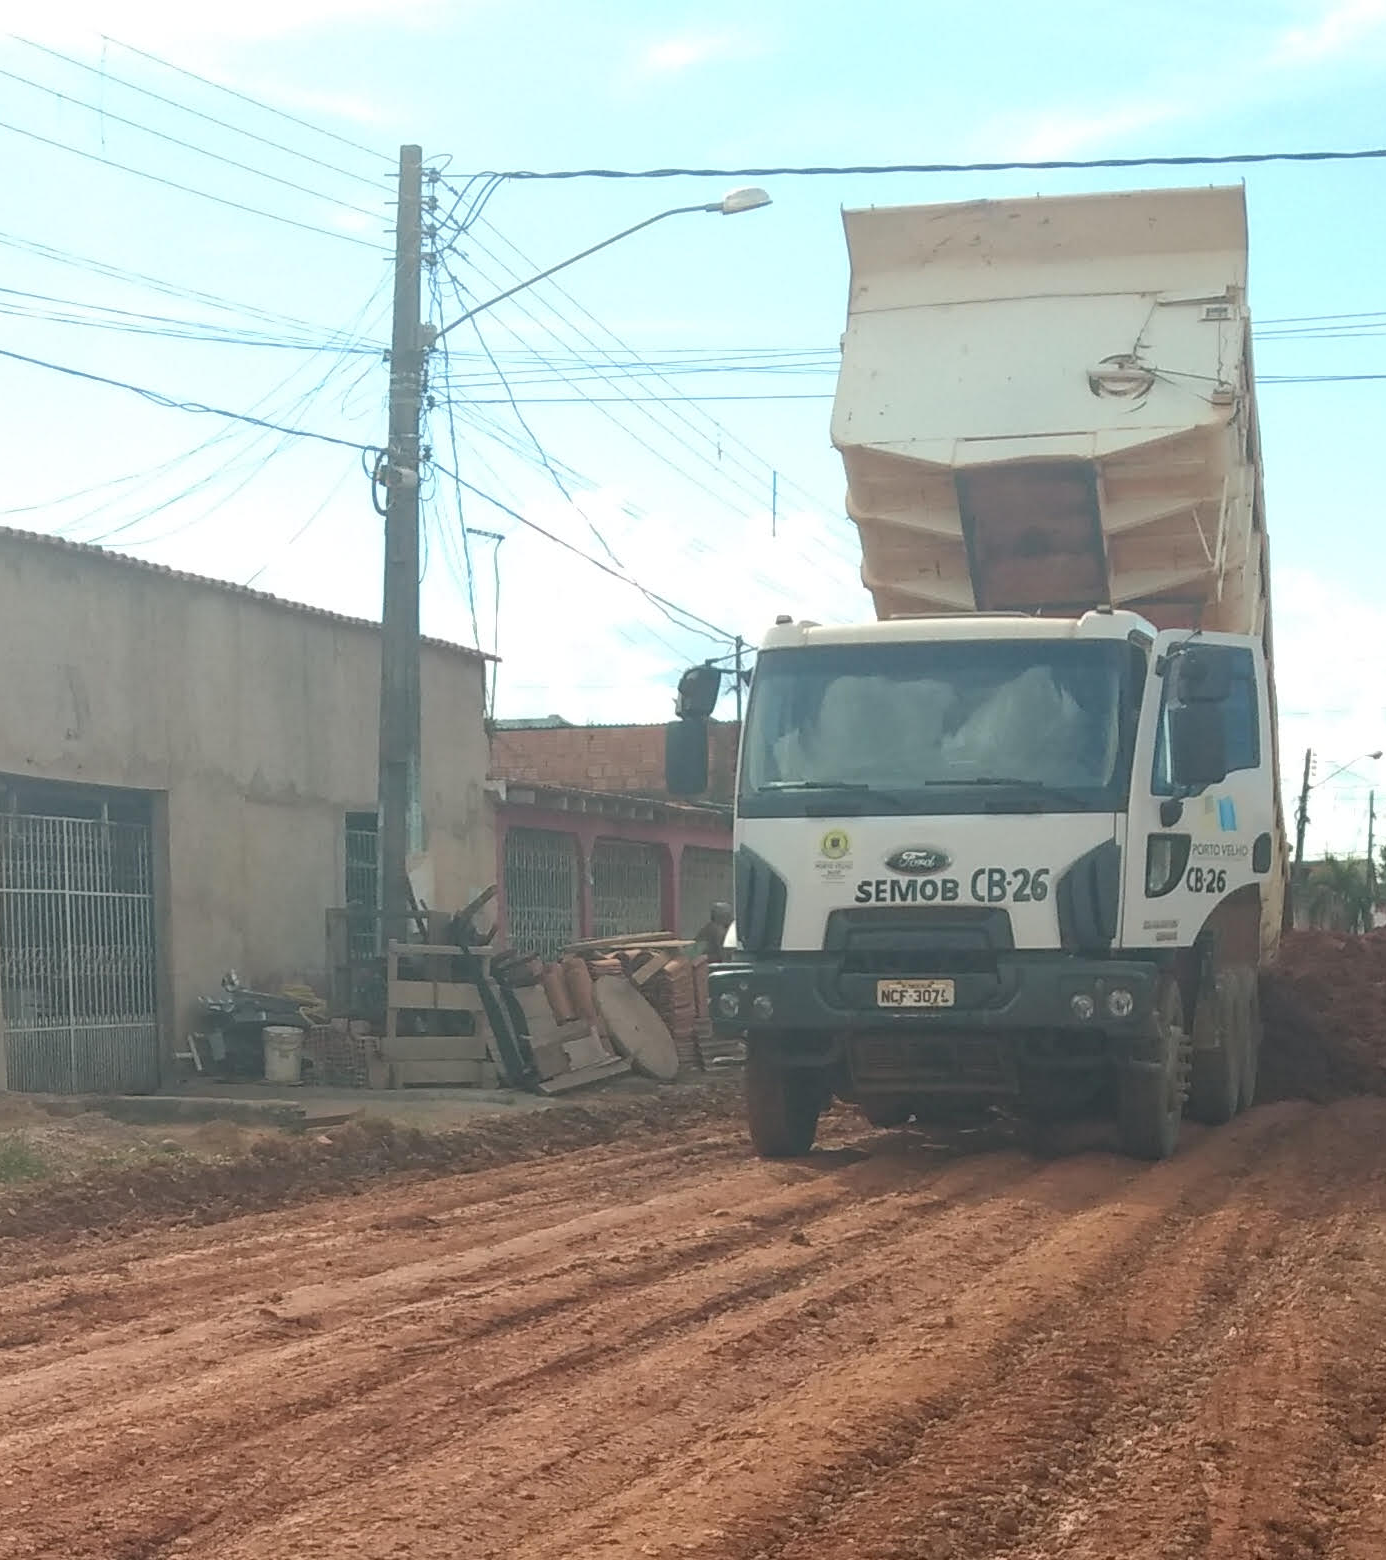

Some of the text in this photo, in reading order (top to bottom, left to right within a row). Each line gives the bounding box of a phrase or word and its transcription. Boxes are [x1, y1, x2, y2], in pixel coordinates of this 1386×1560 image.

[1192, 843, 1249, 857] PORTO VELHO
[900, 851, 936, 868] Ford
[854, 878, 959, 902] SEMOB
